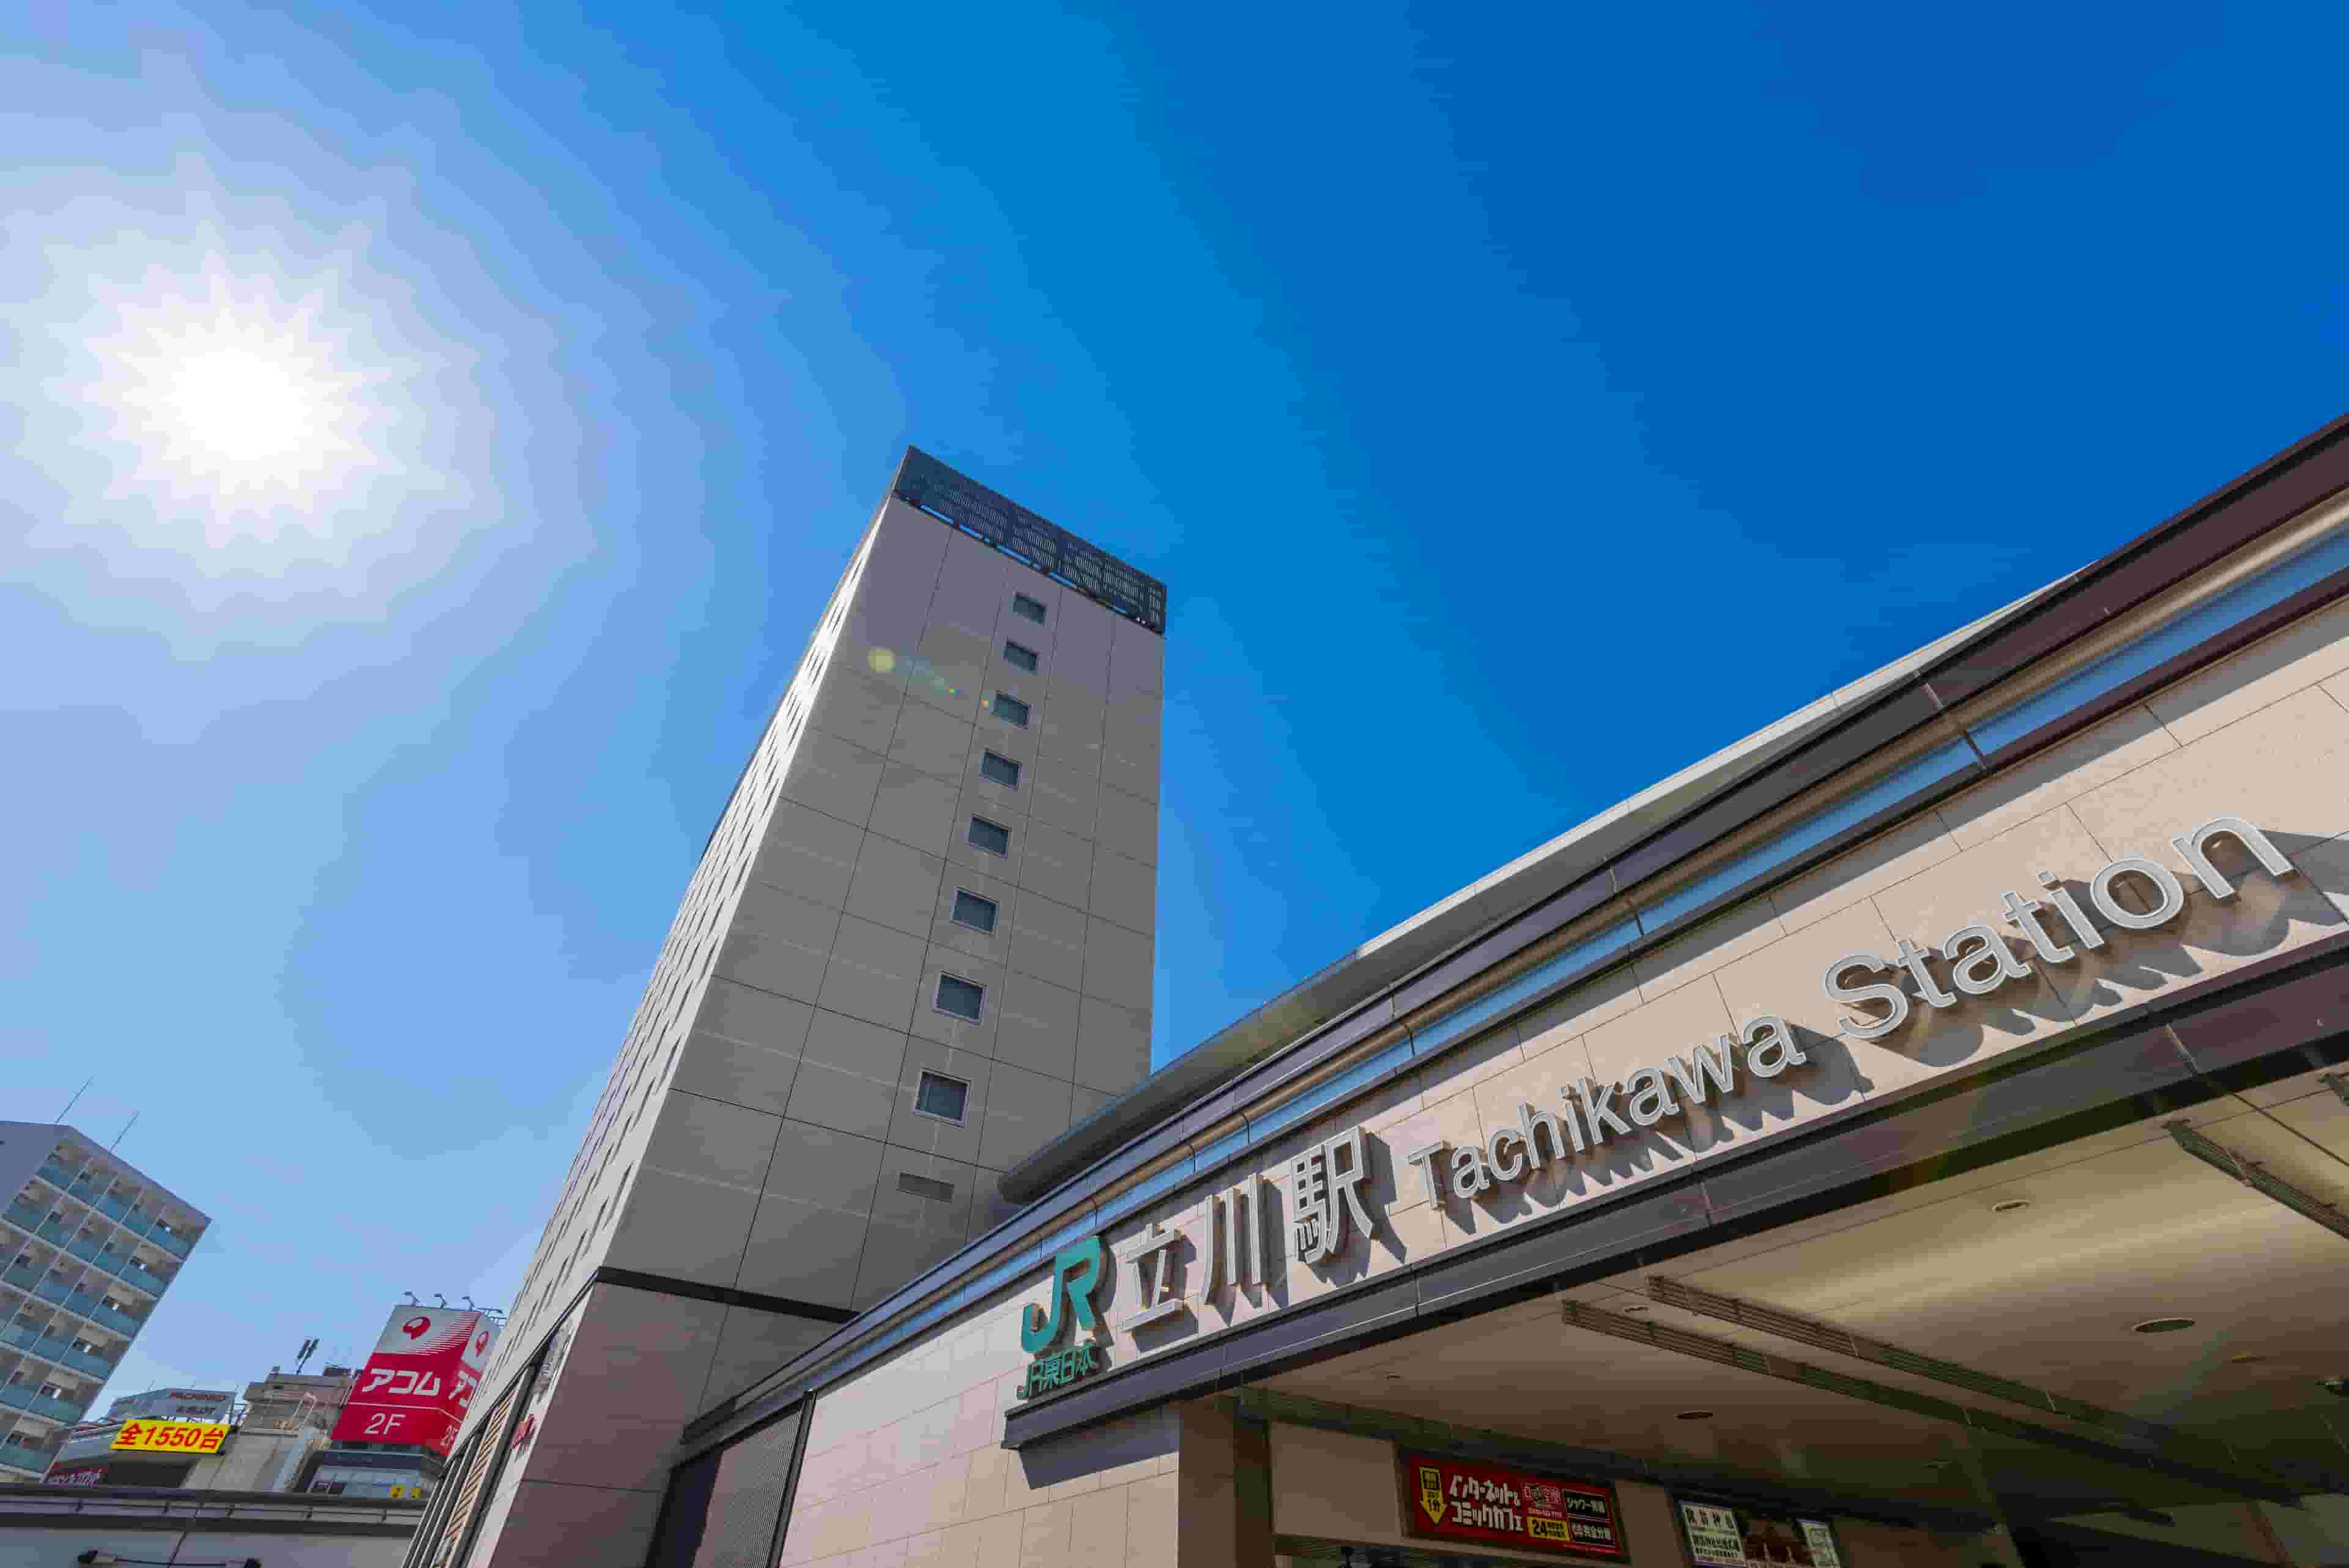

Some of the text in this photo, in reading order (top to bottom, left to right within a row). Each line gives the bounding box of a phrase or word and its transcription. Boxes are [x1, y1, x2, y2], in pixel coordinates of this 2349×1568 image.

[1021, 817, 2297, 1353] JR 立川駅 Tachikawa Station
[362, 1368, 441, 1396] アコム
[1017, 1341, 1099, 1400] JR東日本
[115, 1422, 224, 1449] 全1550台
[363, 1412, 406, 1435] 2F
